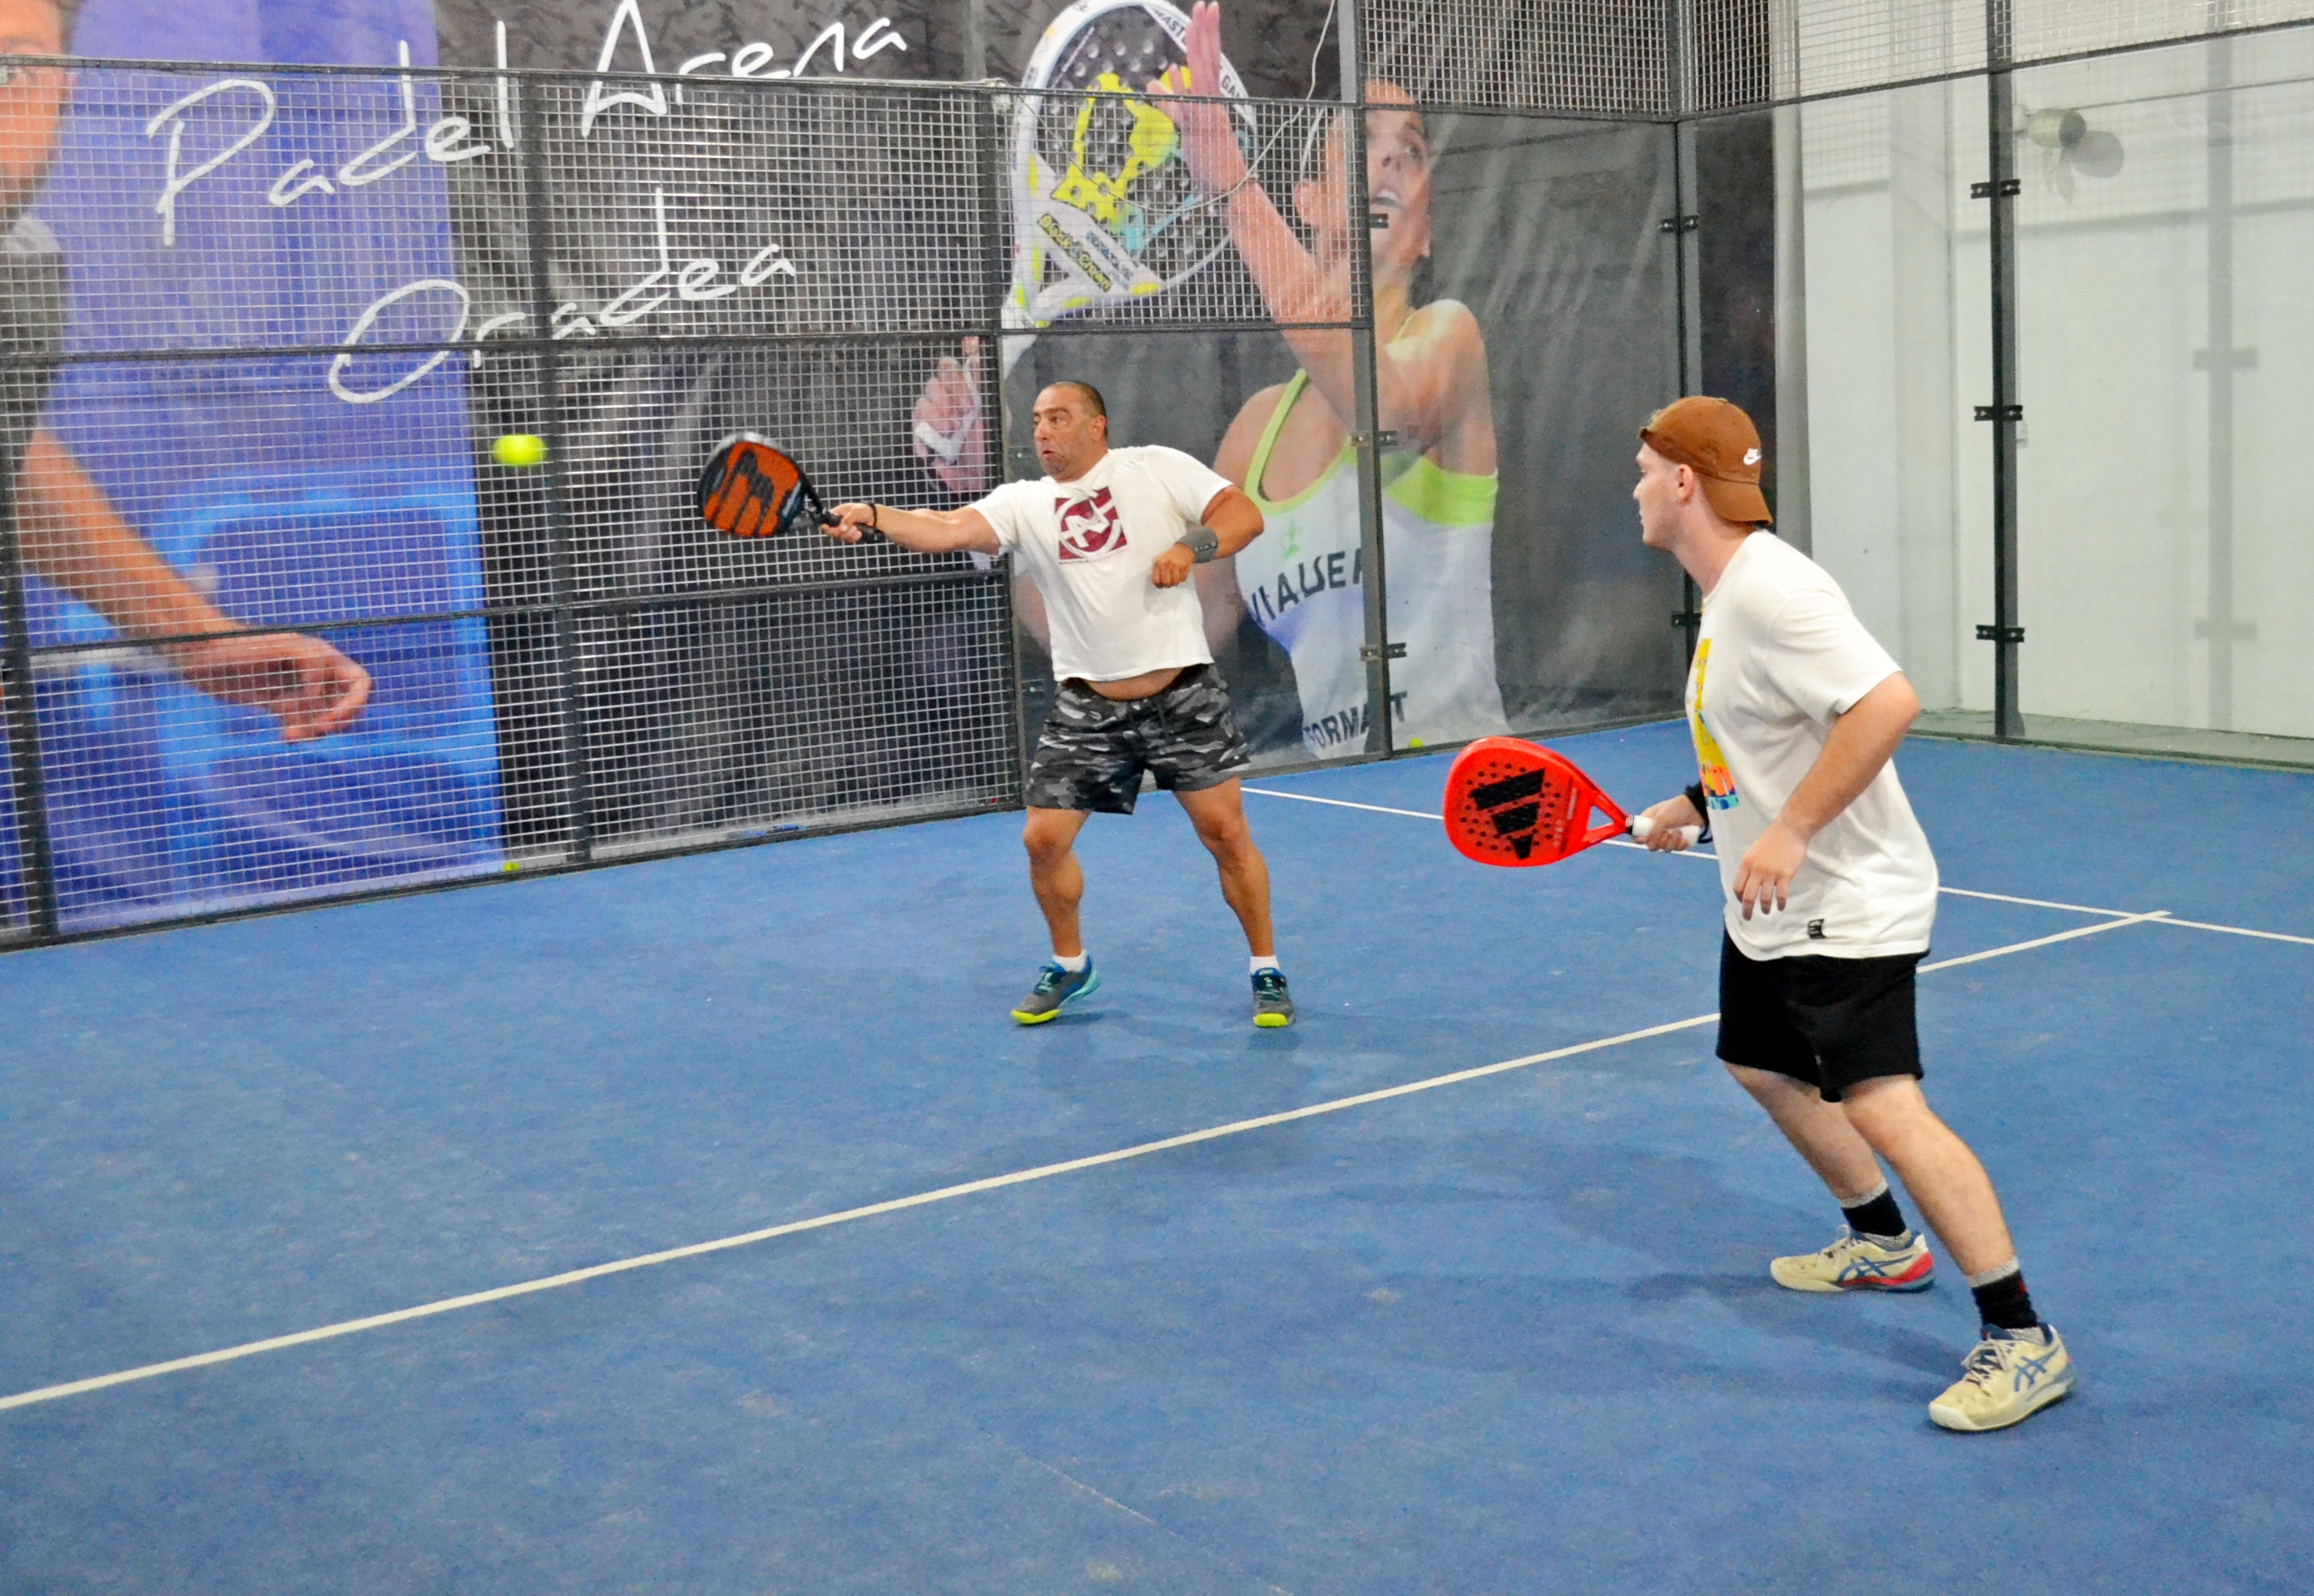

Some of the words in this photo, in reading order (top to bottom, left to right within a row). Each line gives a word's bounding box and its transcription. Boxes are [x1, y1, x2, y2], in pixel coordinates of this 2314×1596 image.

[146, 20, 514, 246] Padel
[581, 0, 907, 138] Arena
[328, 187, 796, 404] Oradea
